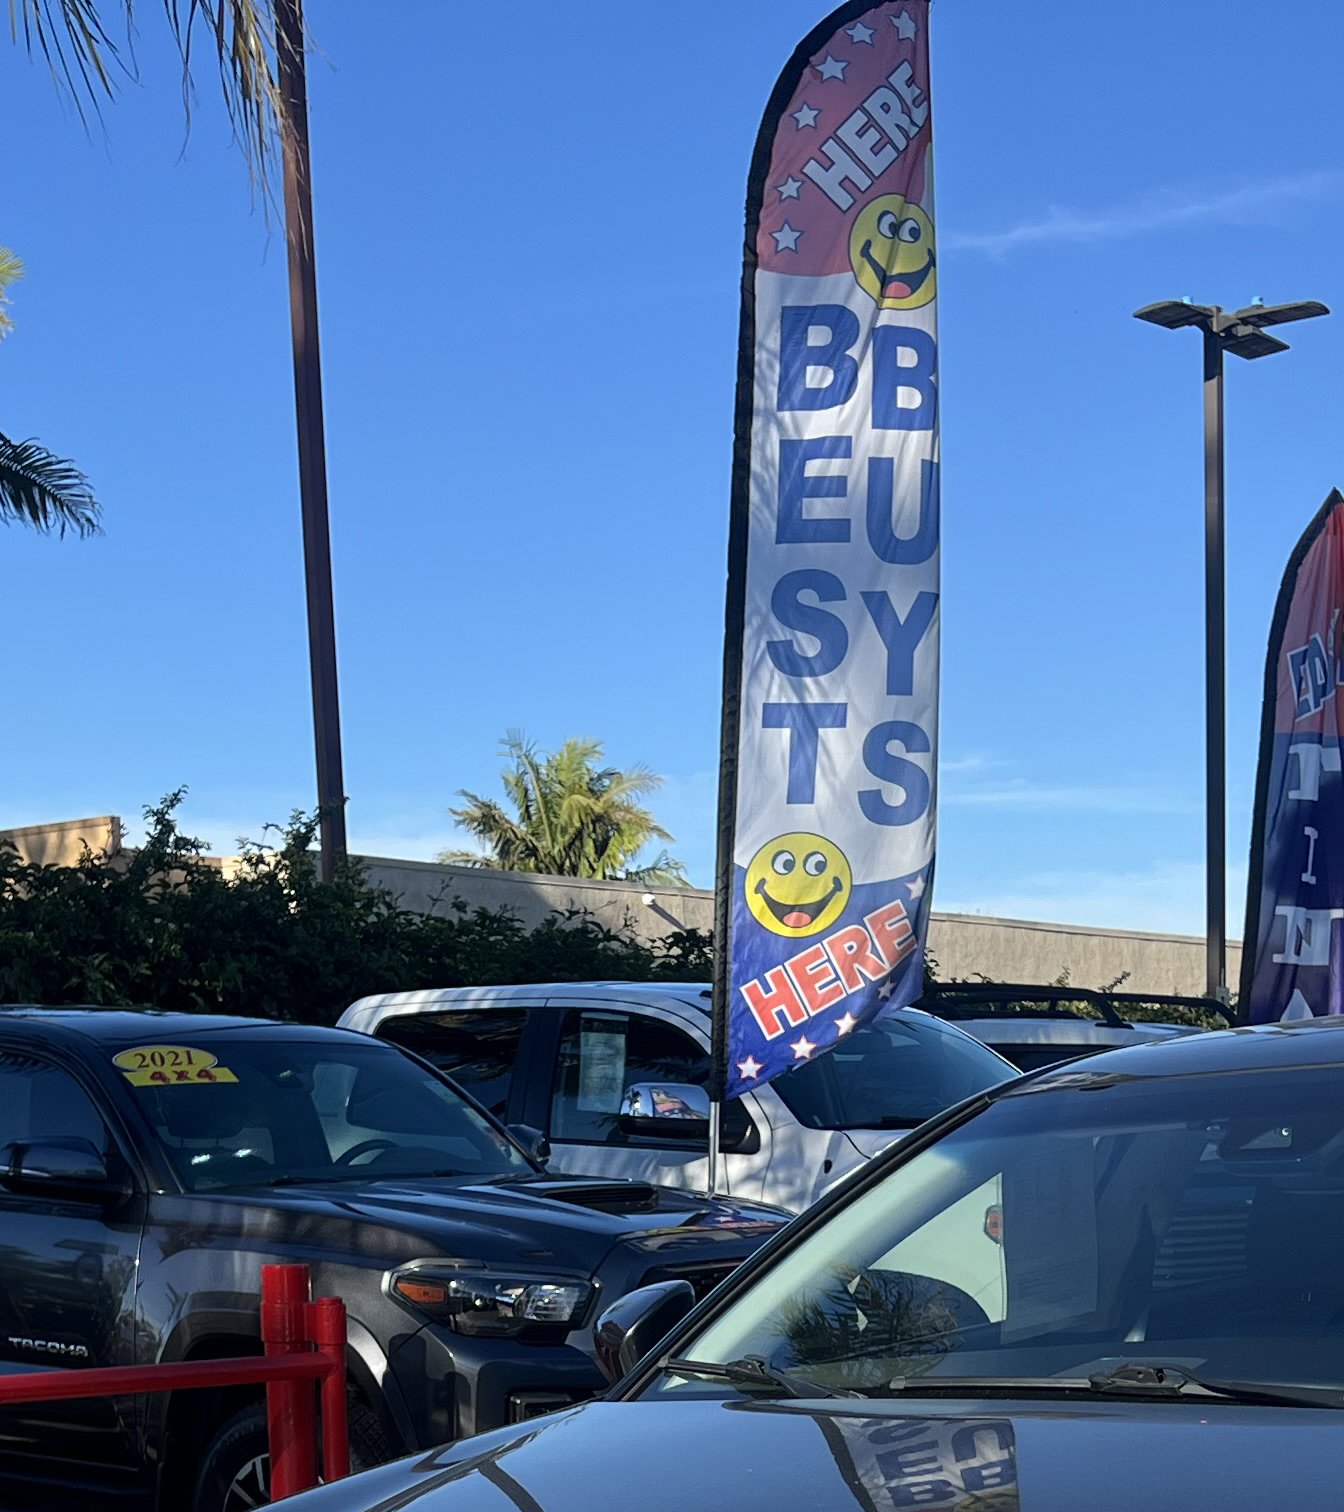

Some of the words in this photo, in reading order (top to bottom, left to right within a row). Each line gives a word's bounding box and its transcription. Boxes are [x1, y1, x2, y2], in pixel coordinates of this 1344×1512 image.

[802, 60, 930, 212] HERE
[761, 304, 859, 805] BEST
[857, 324, 941, 827] BUYS
[740, 899, 918, 1041] HERE
[133, 1049, 194, 1069] 2021
[8, 1336, 89, 1357] TACOMA
